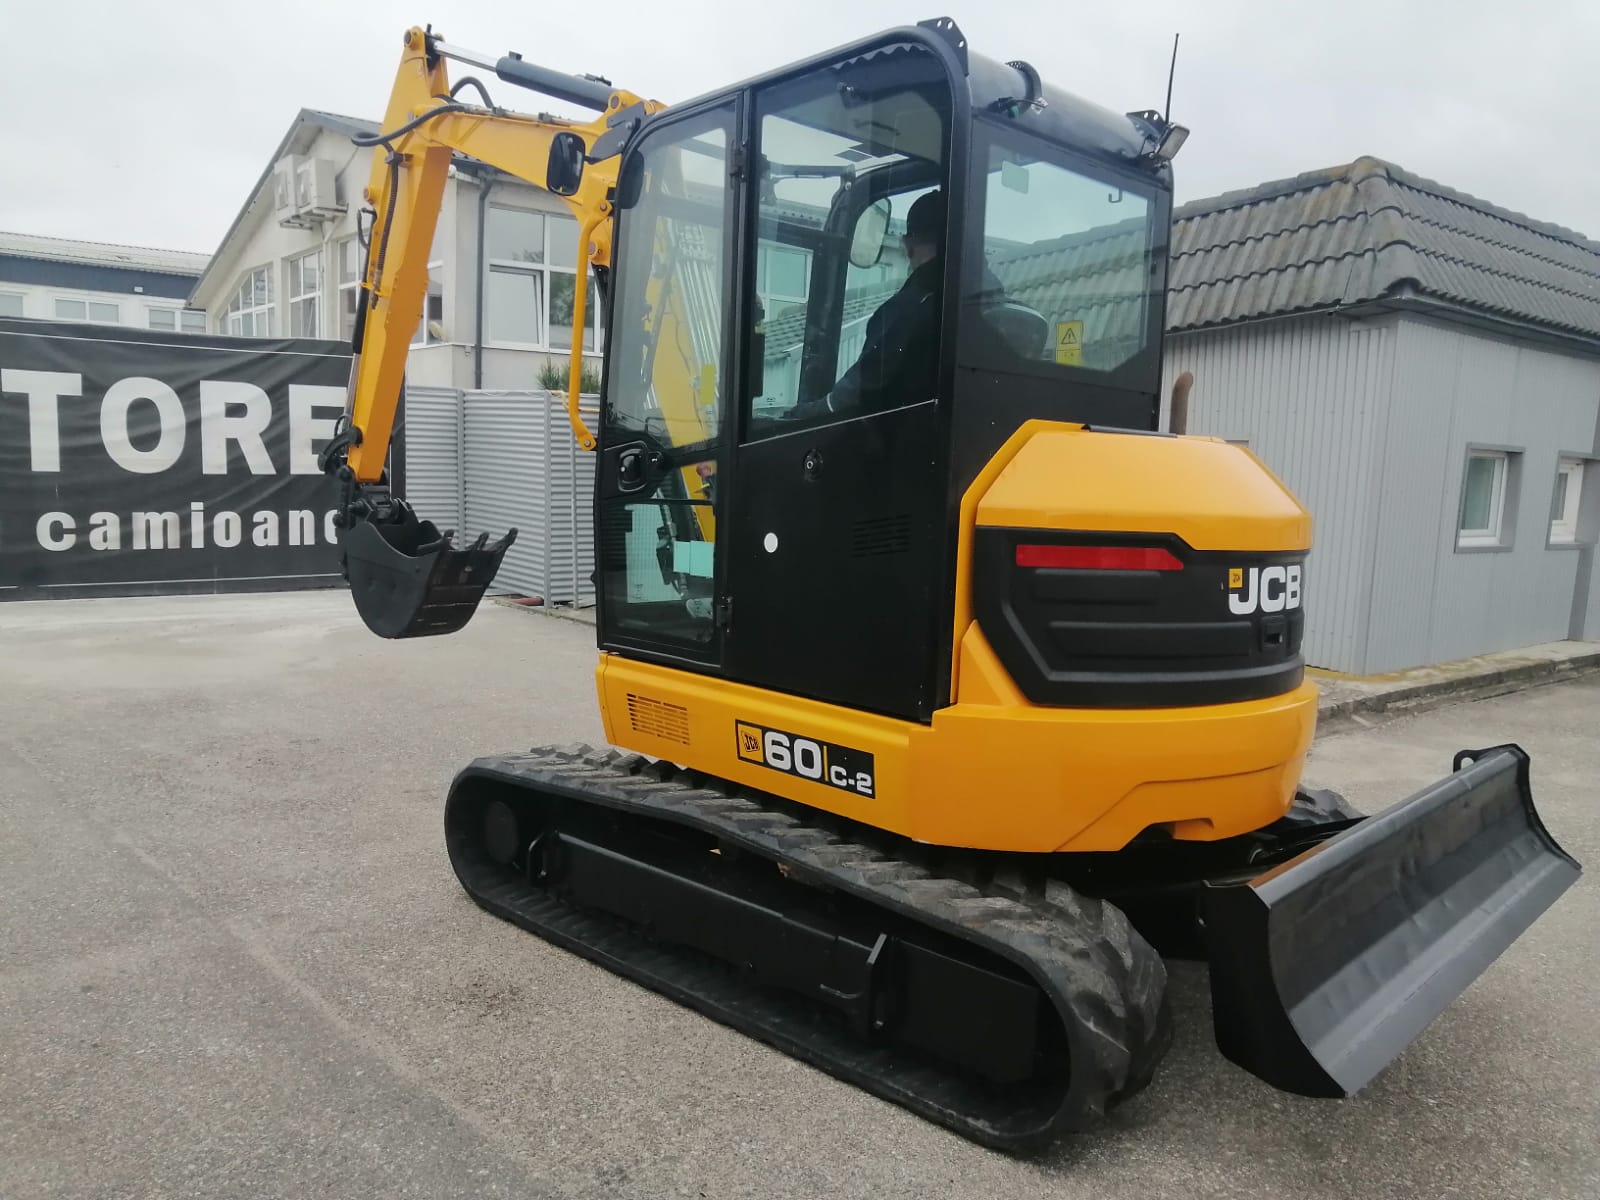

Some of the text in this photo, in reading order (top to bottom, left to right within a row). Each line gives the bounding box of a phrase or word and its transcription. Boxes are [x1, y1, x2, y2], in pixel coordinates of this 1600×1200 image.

[1, 368, 348, 475] TORE
[1228, 565, 1301, 615] JCB
[764, 731, 822, 779] 60
[830, 765, 873, 794] C-2
